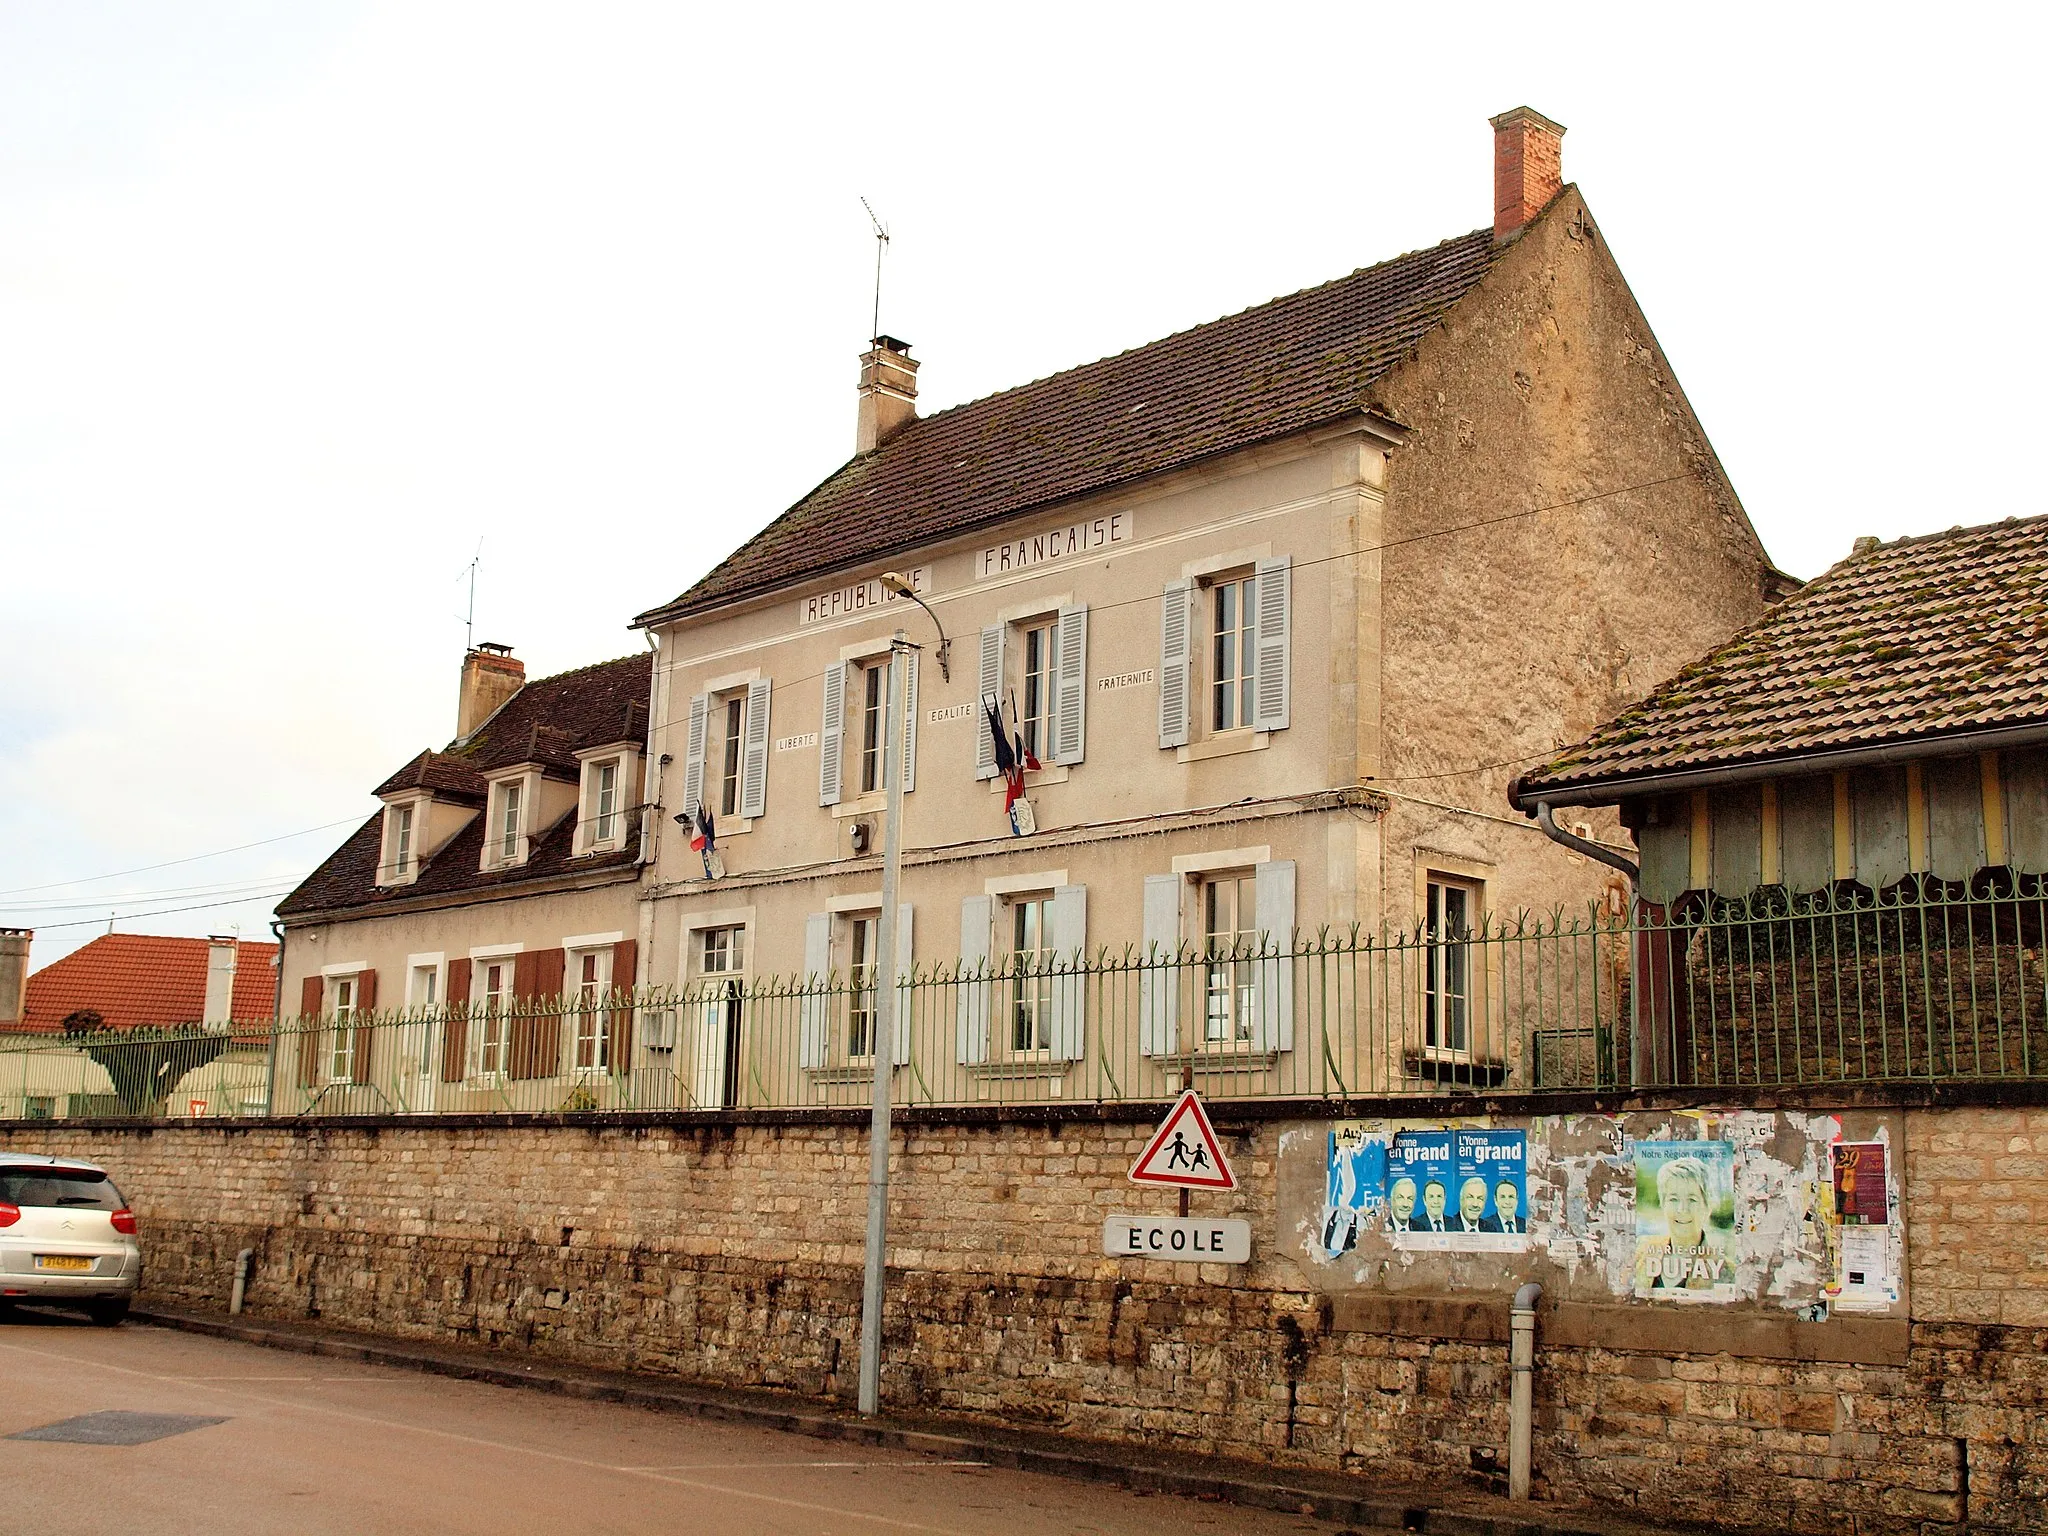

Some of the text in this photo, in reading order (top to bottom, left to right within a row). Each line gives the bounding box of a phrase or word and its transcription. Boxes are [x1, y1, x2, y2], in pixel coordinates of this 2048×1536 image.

[807, 568, 923, 621] REPUBLIE
[1098, 670, 1153, 691] FRATERNITE
[931, 705, 971, 722] EGALITE
[779, 734, 814, 750] LIBERTE
[1458, 1135, 1489, 1147] L'Yonne
[1404, 1143, 1450, 1164] grand
[1459, 1142, 1522, 1163] en grand
[1641, 1149, 1662, 1159] Notre
[1128, 1228, 1224, 1252] ECOLE
[1645, 1256, 1725, 1280] DUFAY
